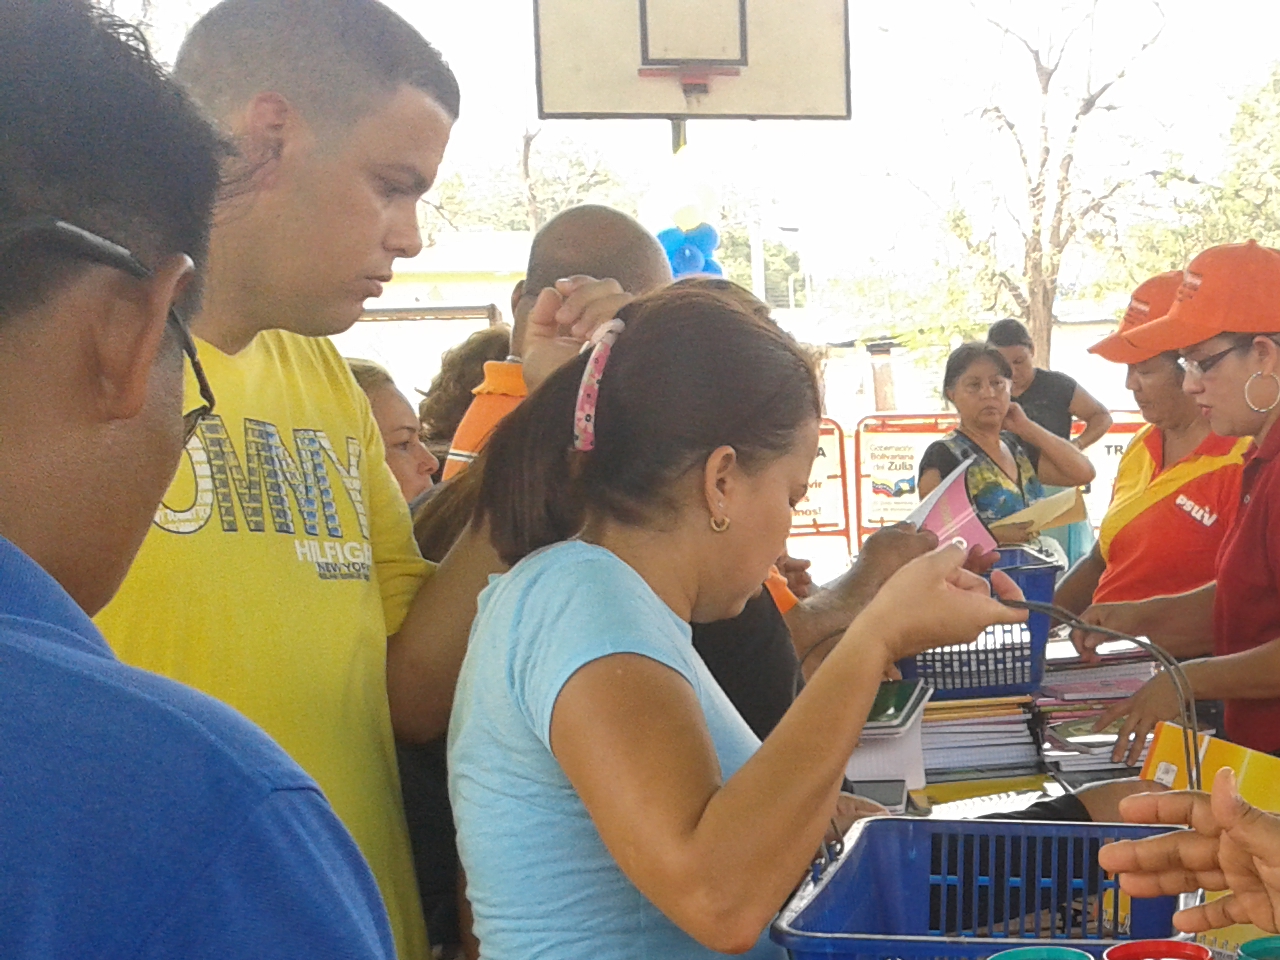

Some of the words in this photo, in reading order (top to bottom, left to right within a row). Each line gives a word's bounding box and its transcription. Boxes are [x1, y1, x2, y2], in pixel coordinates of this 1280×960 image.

[1104, 444, 1124, 456] TR
[887, 461, 914, 471] Zulia
[153, 414, 369, 540] OMMY
